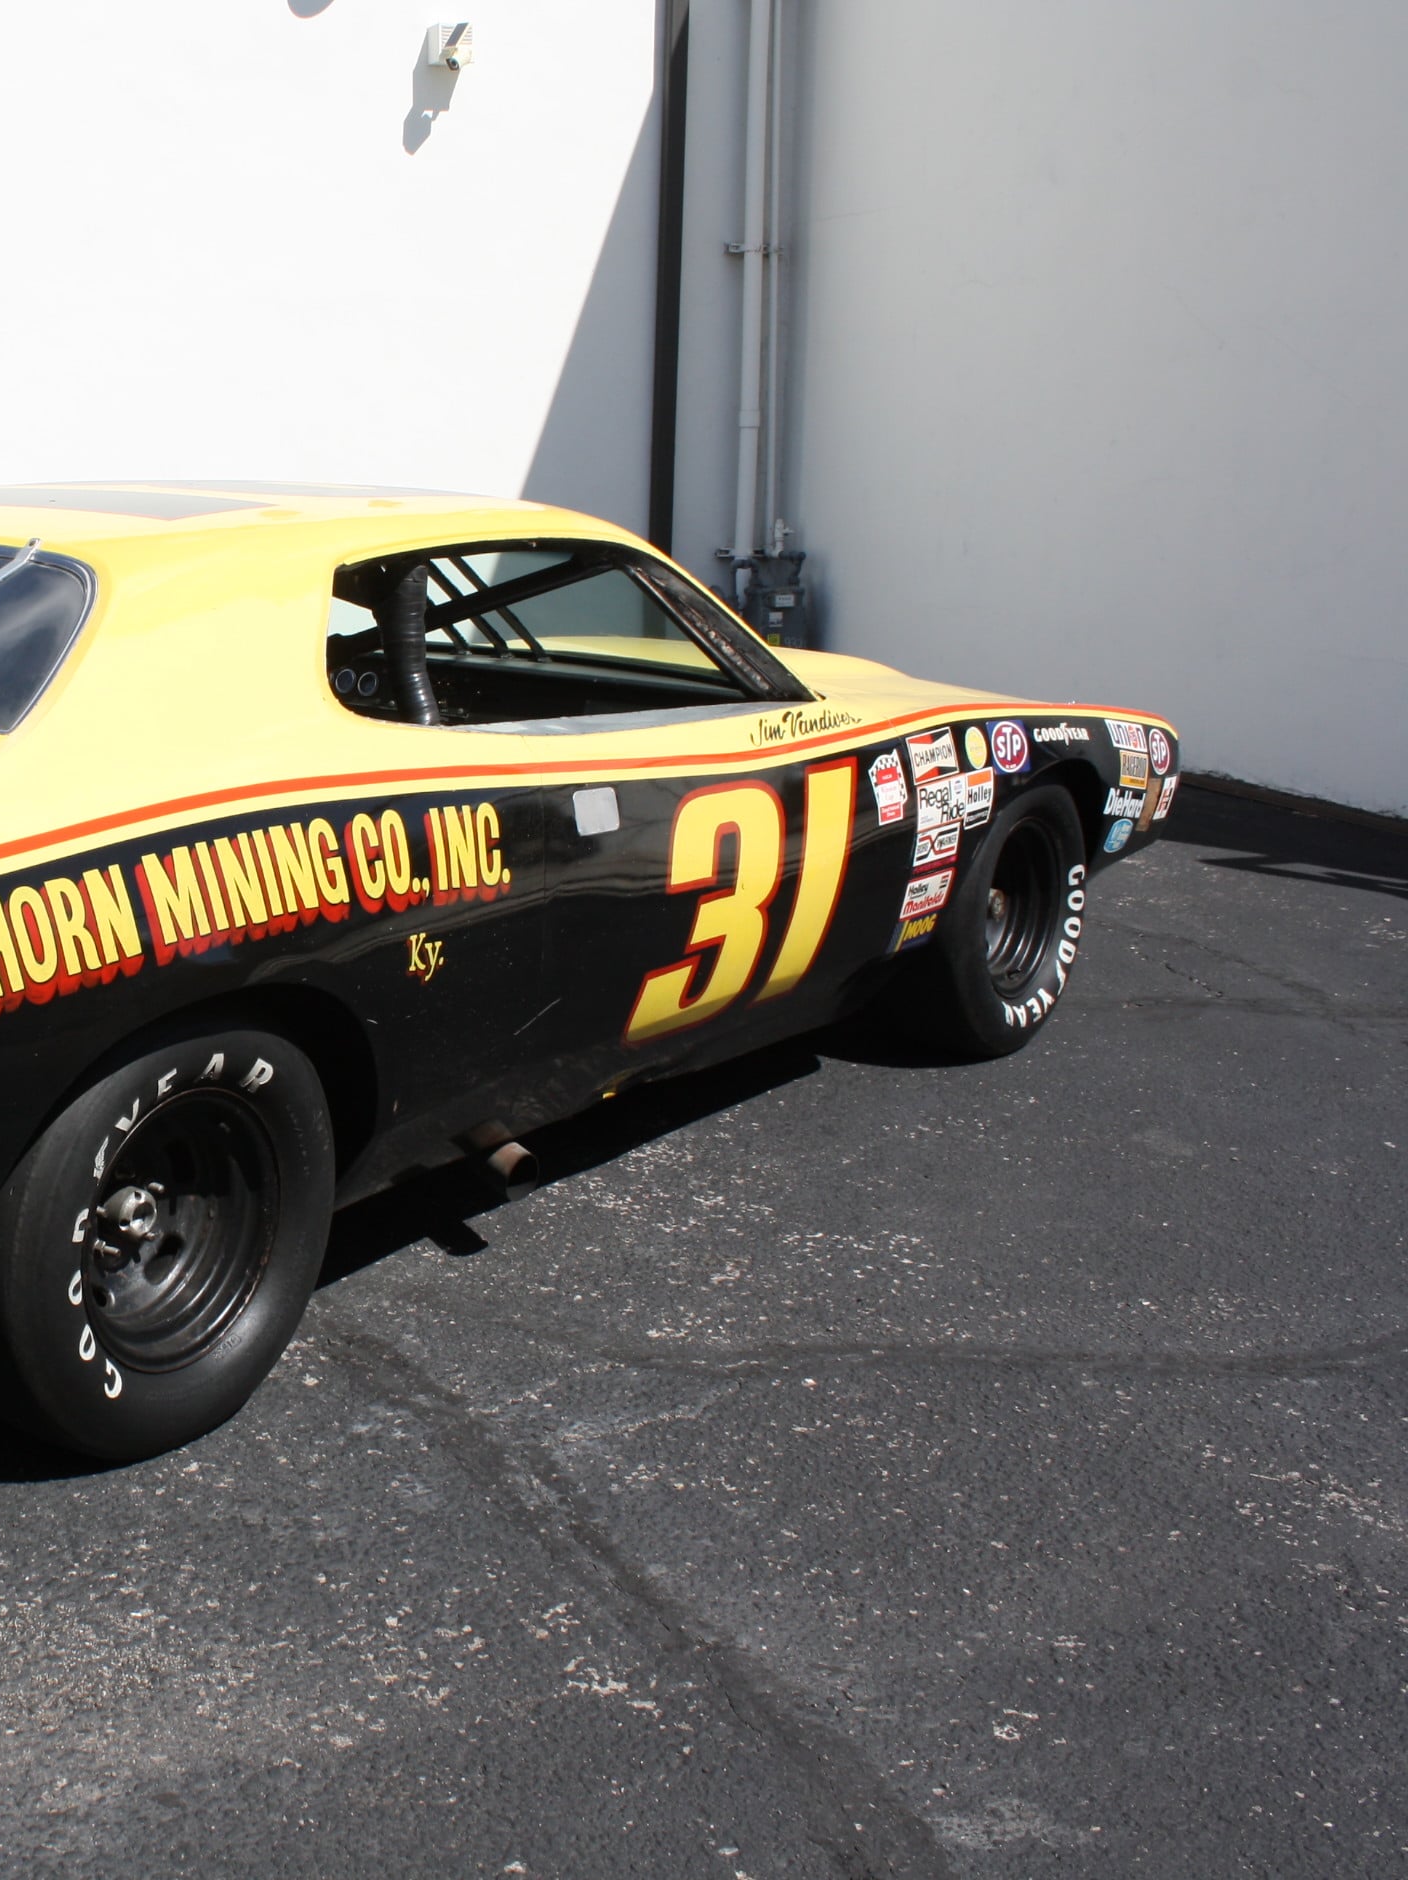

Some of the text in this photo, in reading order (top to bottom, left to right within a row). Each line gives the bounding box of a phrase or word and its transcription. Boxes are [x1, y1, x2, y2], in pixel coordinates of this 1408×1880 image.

[750, 709, 863, 747] Jim Vandiver
[1033, 722, 1090, 747] GOODYEAR
[914, 744, 952, 767] CHAMPION
[996, 726, 1022, 762] STP
[1152, 733, 1167, 764] STP
[919, 780, 953, 810] Regal
[967, 786, 992, 805] Holley
[1103, 787, 1146, 818] DieHard
[940, 798, 966, 824] Ride
[137, 820, 352, 967] MINING
[342, 809, 432, 918] CO.,
[422, 800, 514, 907] INC.
[622, 757, 862, 1047] 31
[903, 913, 938, 941] MOOG
[404, 930, 448, 982] Ky.
[1001, 864, 1086, 1028] GOODYEAR
